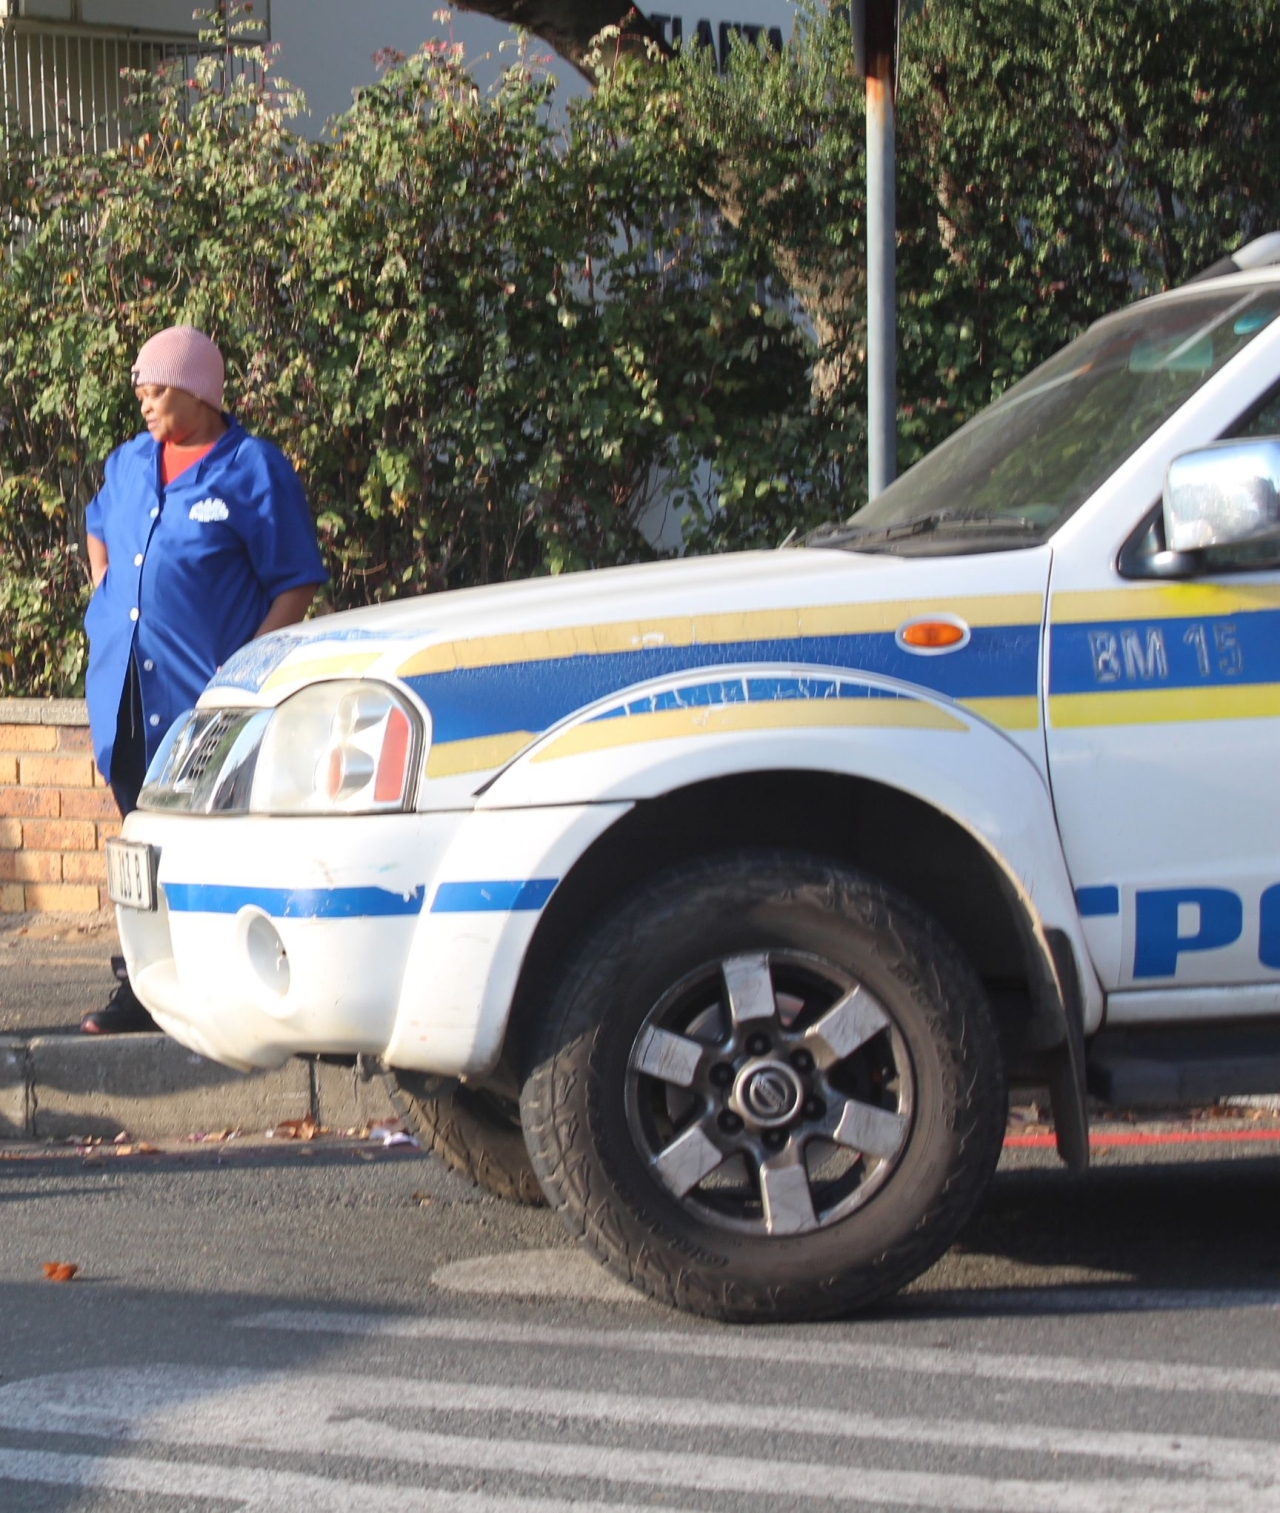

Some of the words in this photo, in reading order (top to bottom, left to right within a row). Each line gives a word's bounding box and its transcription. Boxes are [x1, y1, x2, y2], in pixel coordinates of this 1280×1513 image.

[1088, 625, 1168, 683] BM
[1183, 622, 1244, 677] 15
[1132, 881, 1280, 980] P
